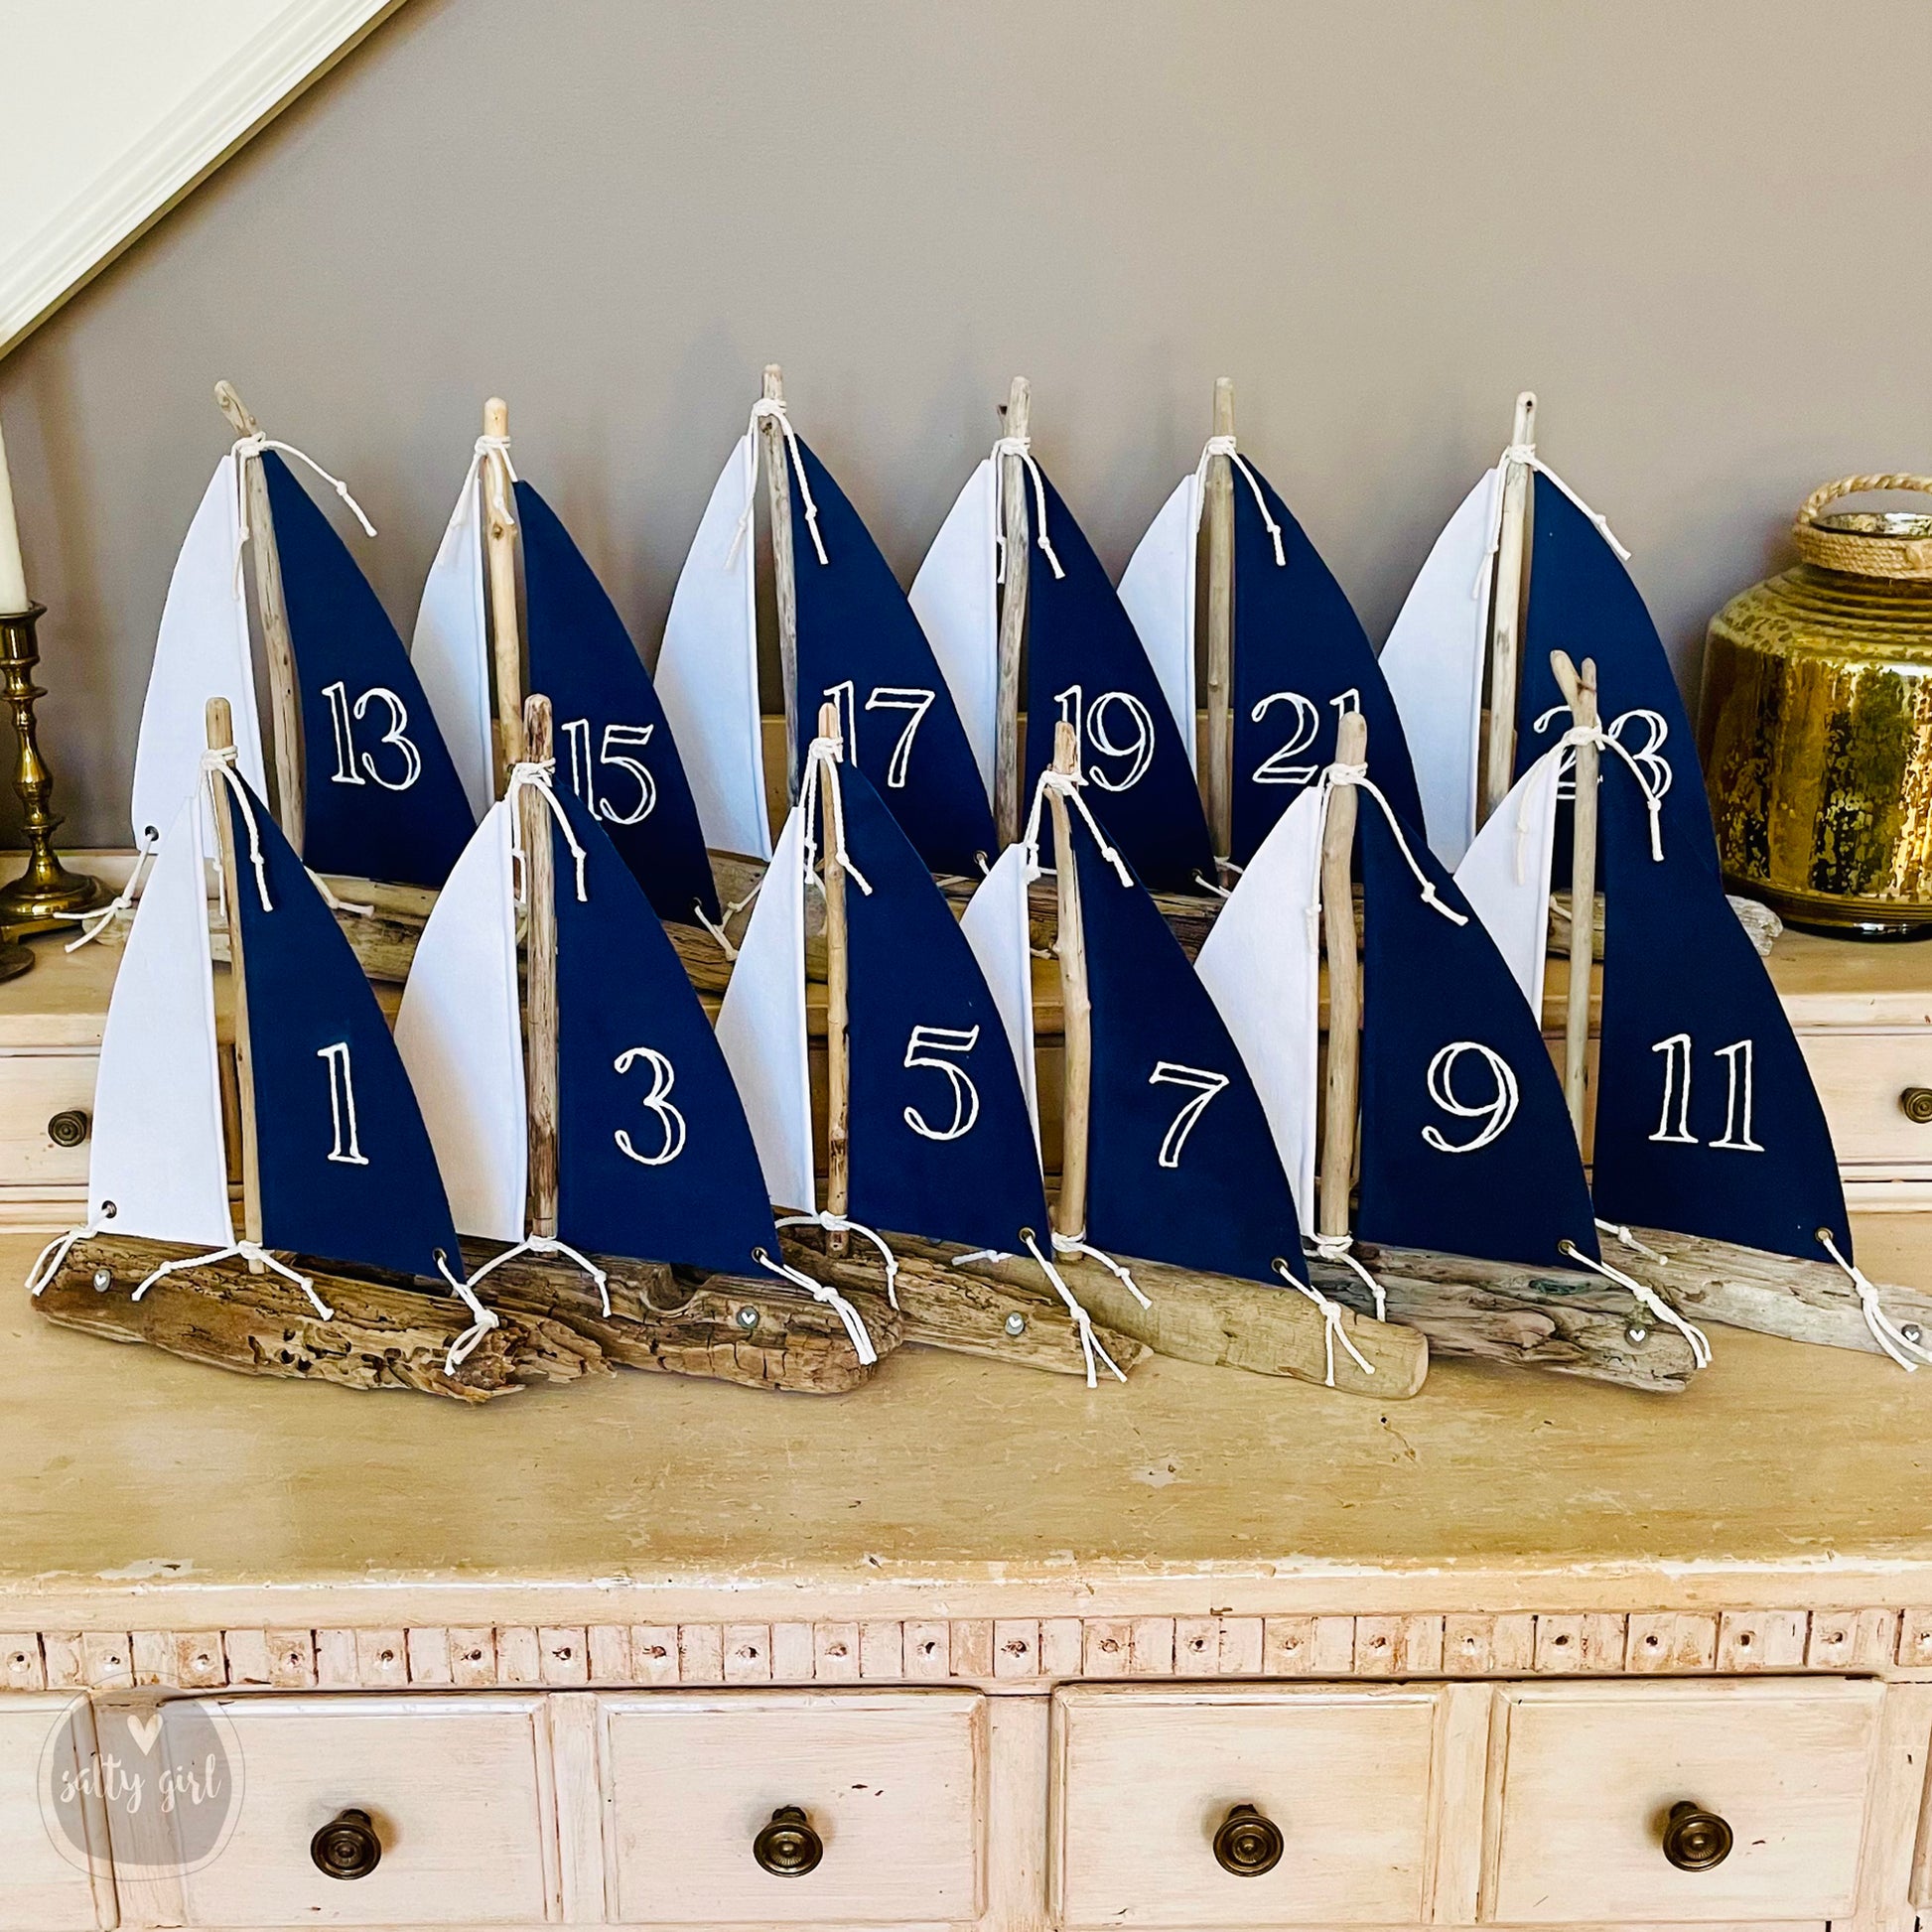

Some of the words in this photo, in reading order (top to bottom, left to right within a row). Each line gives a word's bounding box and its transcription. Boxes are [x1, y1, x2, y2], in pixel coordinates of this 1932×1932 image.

[321, 681, 422, 791] 13
[561, 718, 656, 825] 15
[823, 680, 936, 788] 17
[1053, 684, 1156, 792] 19
[1251, 688, 1360, 784] 2
[317, 1041, 369, 1166] 1
[614, 1046, 686, 1166] 3
[903, 1024, 980, 1141] 5
[1148, 1060, 1230, 1169] 7
[1421, 1041, 1520, 1153] 9
[1648, 1033, 1765, 1152] 11
